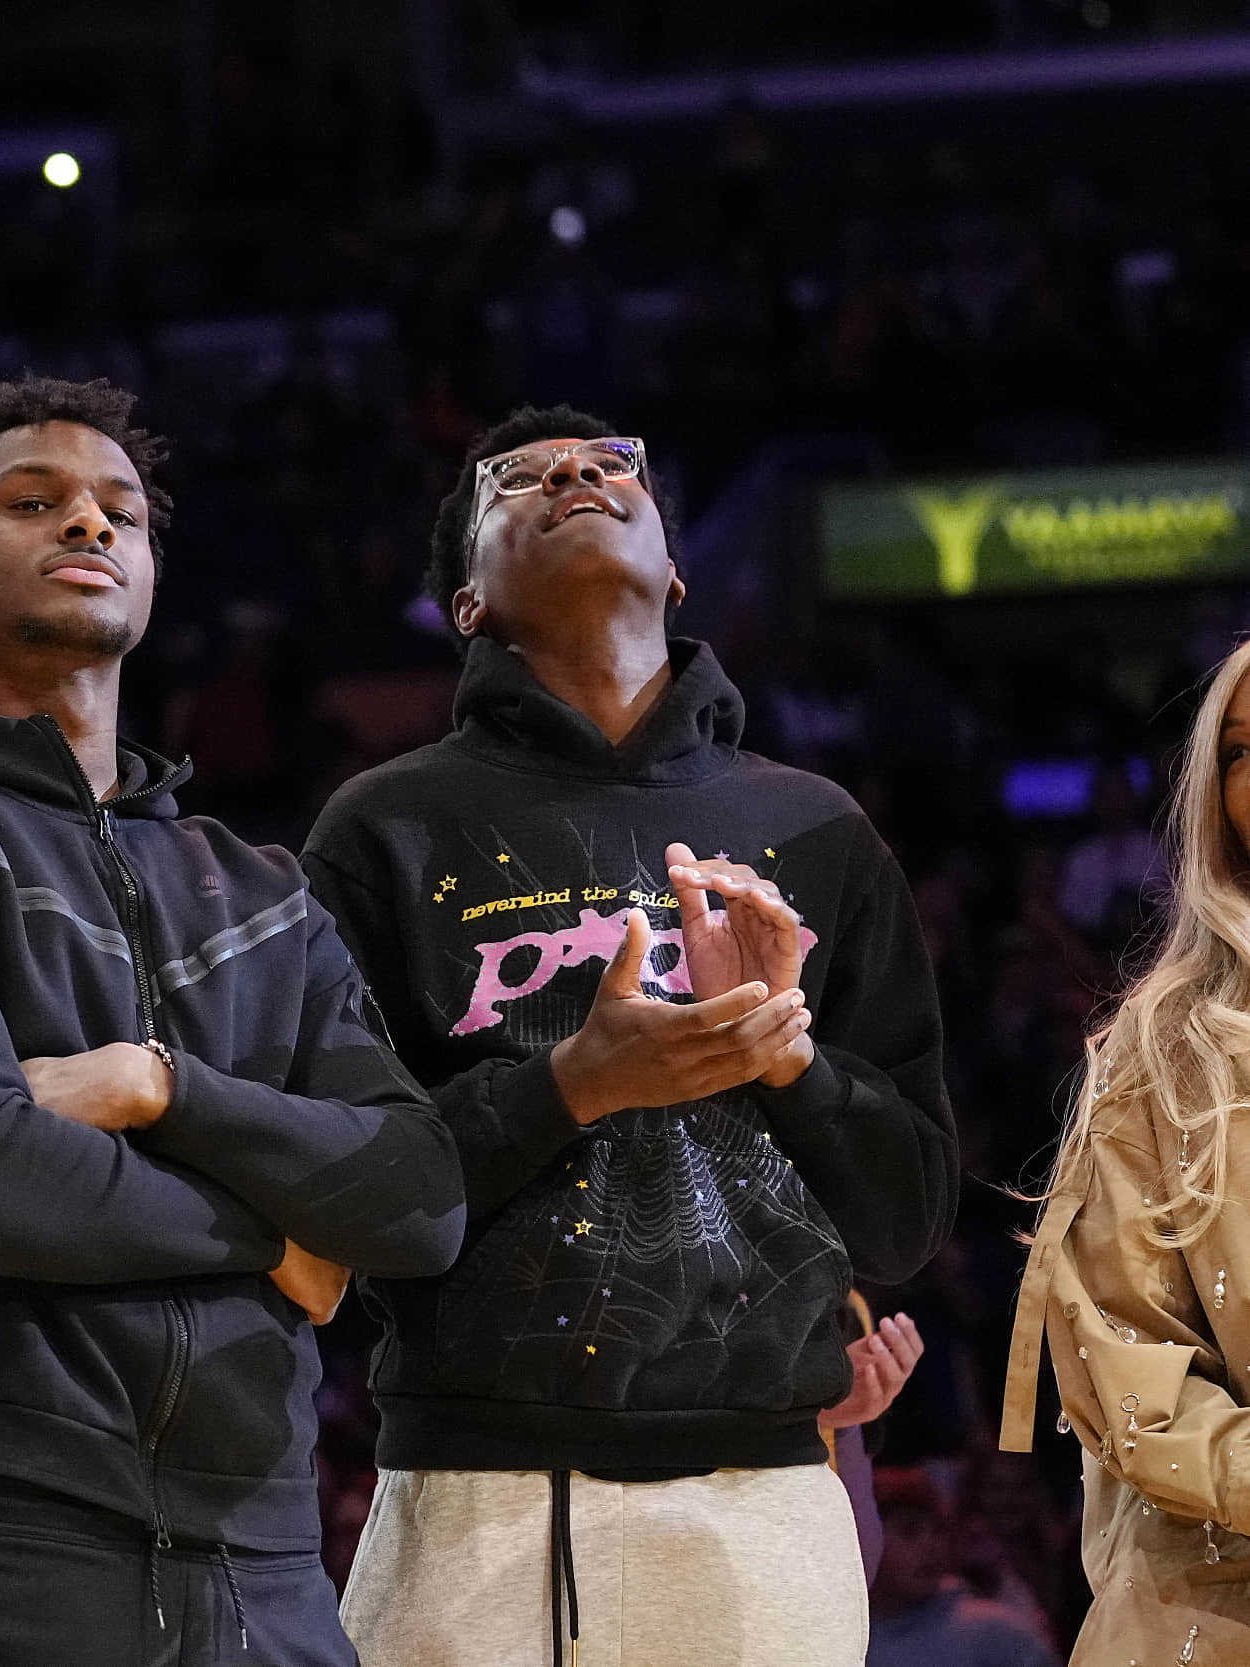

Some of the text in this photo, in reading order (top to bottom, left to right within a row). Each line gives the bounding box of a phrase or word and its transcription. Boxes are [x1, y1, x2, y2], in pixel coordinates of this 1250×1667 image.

[461, 886, 680, 921] nevermind the spide
